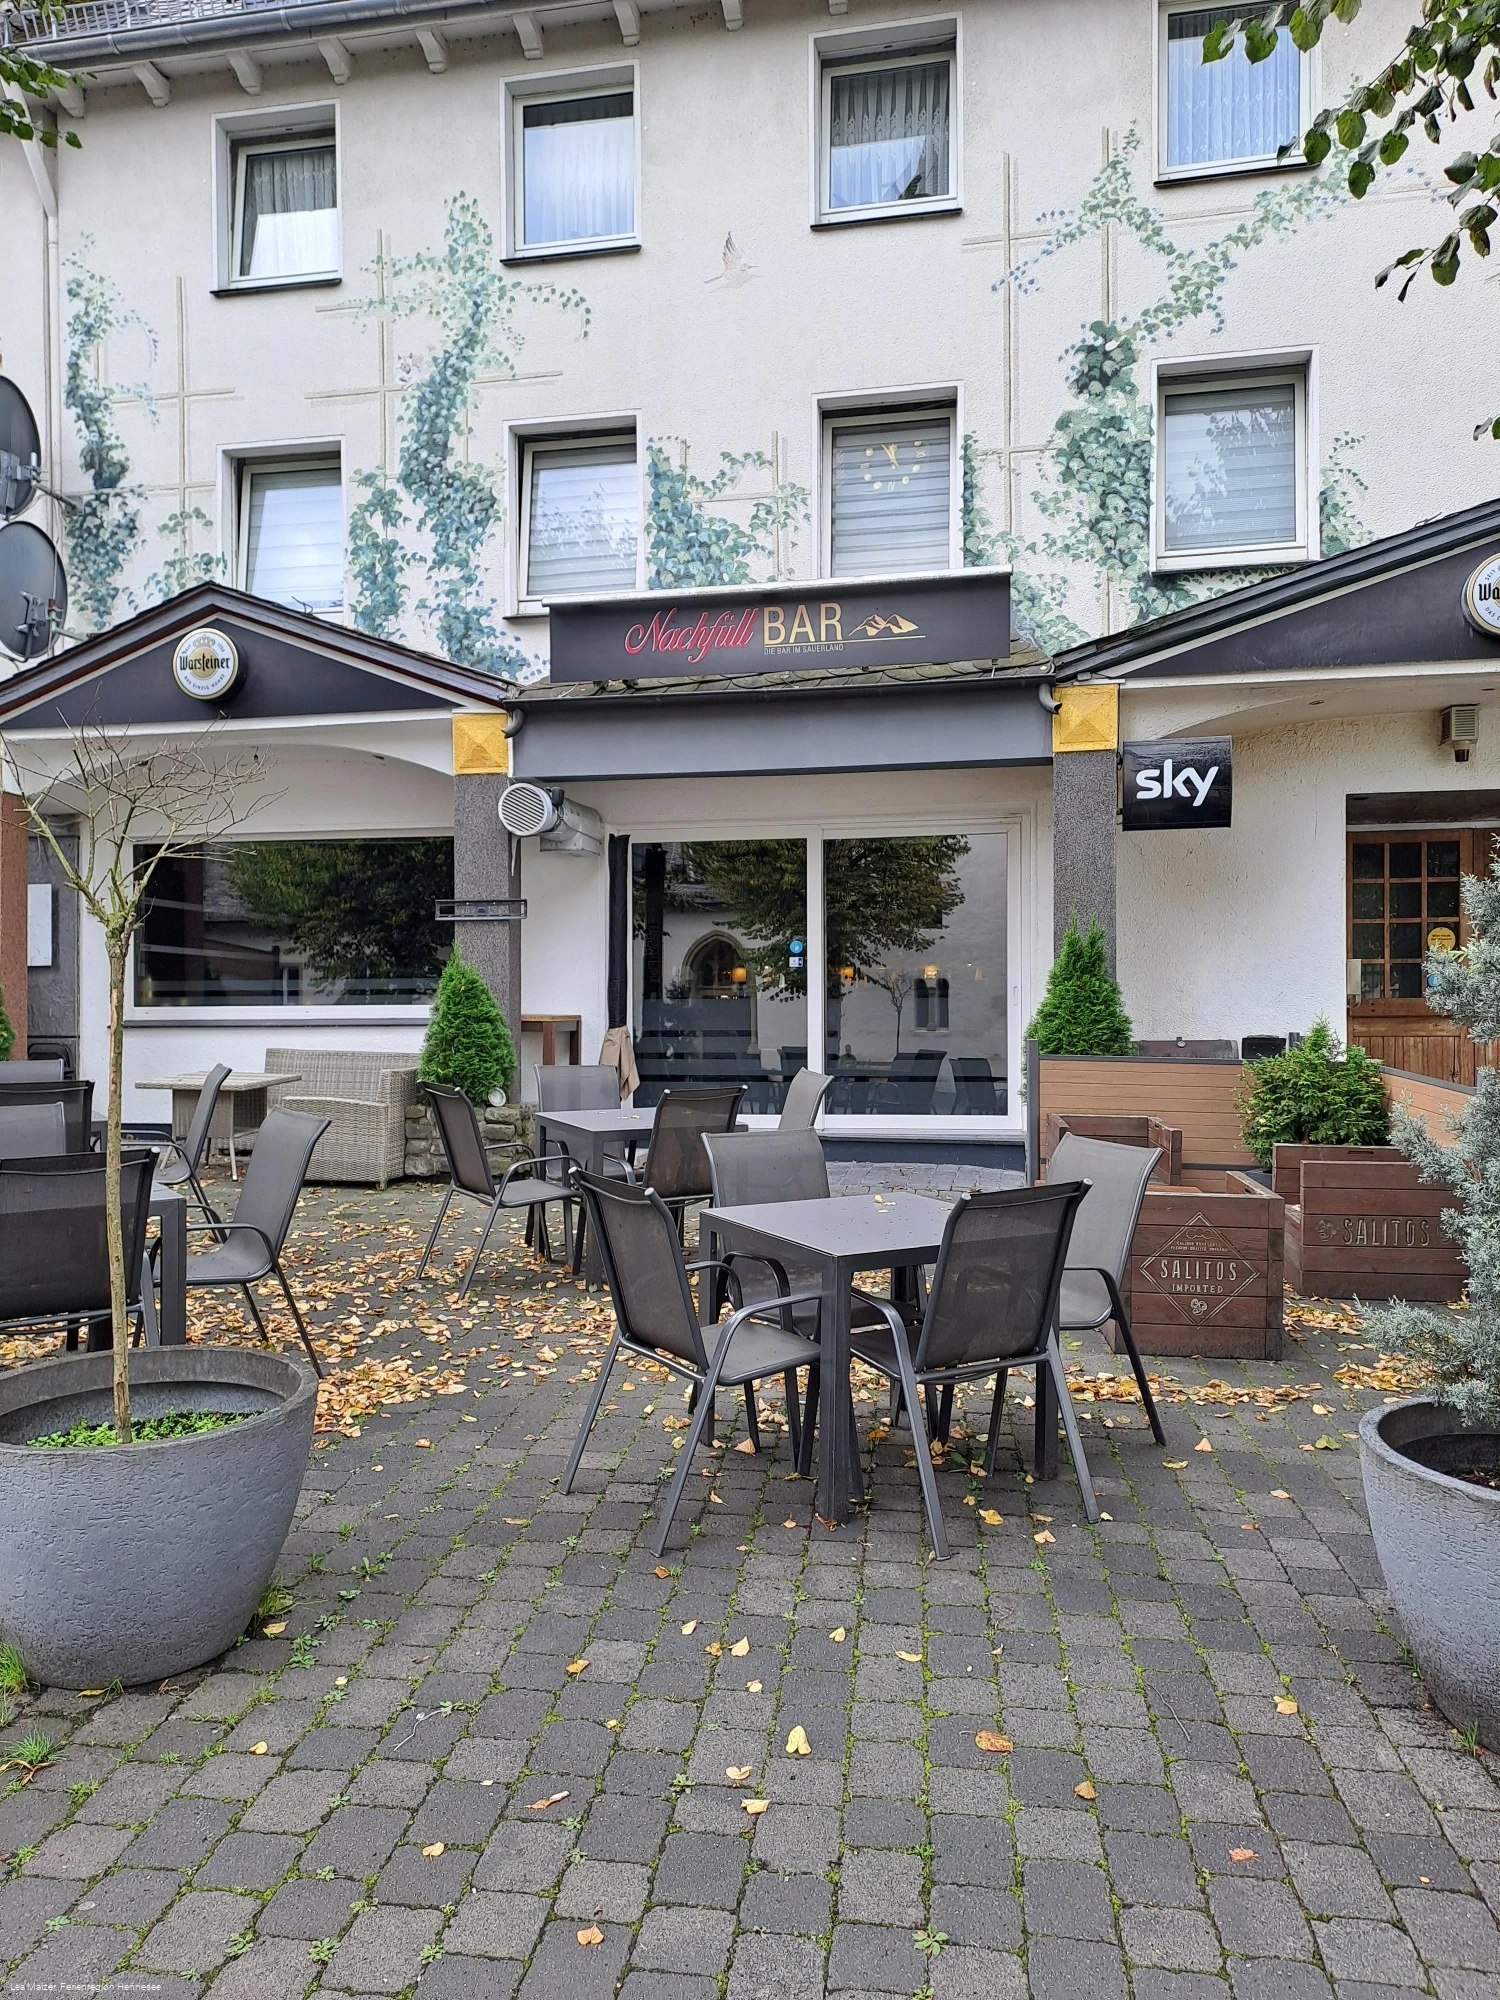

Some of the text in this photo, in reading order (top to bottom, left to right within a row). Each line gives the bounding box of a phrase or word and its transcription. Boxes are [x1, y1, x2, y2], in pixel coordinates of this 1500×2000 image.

[624, 602, 843, 665] Nachfüll BAR
[764, 643, 844, 655] DIE BAR IM SAUERLAND
[180, 653, 231, 671] Warsteiner
[1135, 758, 1220, 807] sky
[1343, 1218, 1430, 1247] SALITOS
[1160, 1259, 1237, 1281] SALITOS
[1172, 1283, 1223, 1294] IMPORTED
